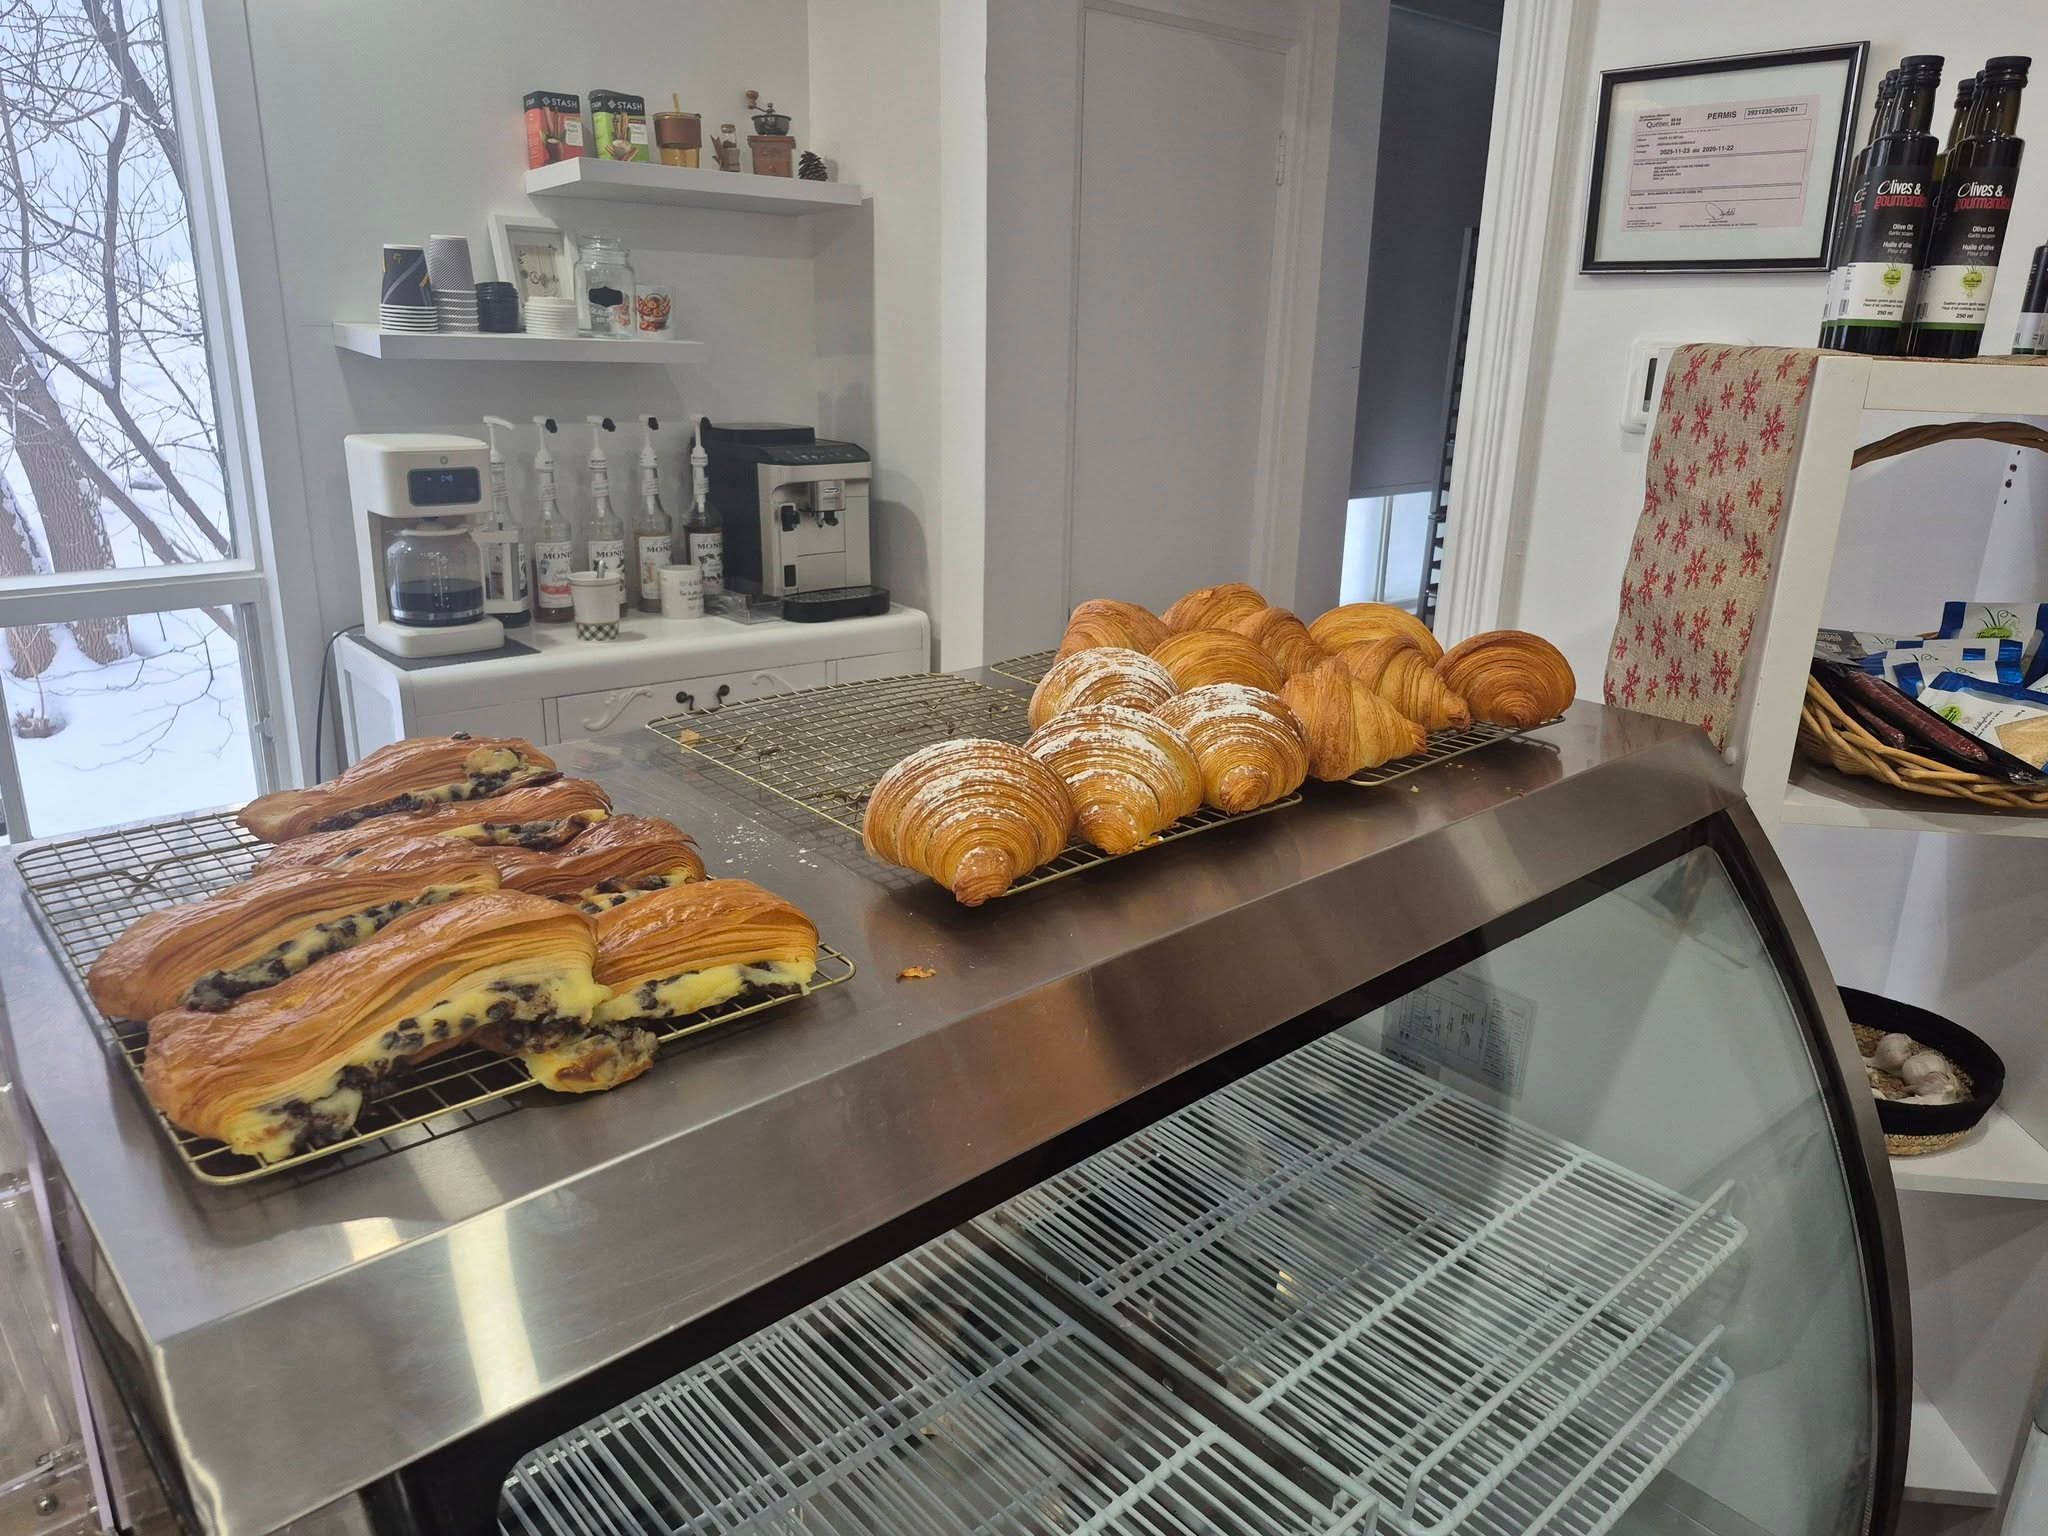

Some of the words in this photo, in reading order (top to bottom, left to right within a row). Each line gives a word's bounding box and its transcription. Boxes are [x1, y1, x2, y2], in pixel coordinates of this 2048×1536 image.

[551, 98, 578, 108] STASH
[617, 101, 643, 111] STASH
[1707, 111, 1737, 120] PERMIS
[1646, 121, 1670, 129] Québec
[1877, 179, 1913, 195] Olives
[1914, 183, 1922, 195] &
[1957, 182, 1994, 197] Olives
[1995, 185, 2004, 197] &
